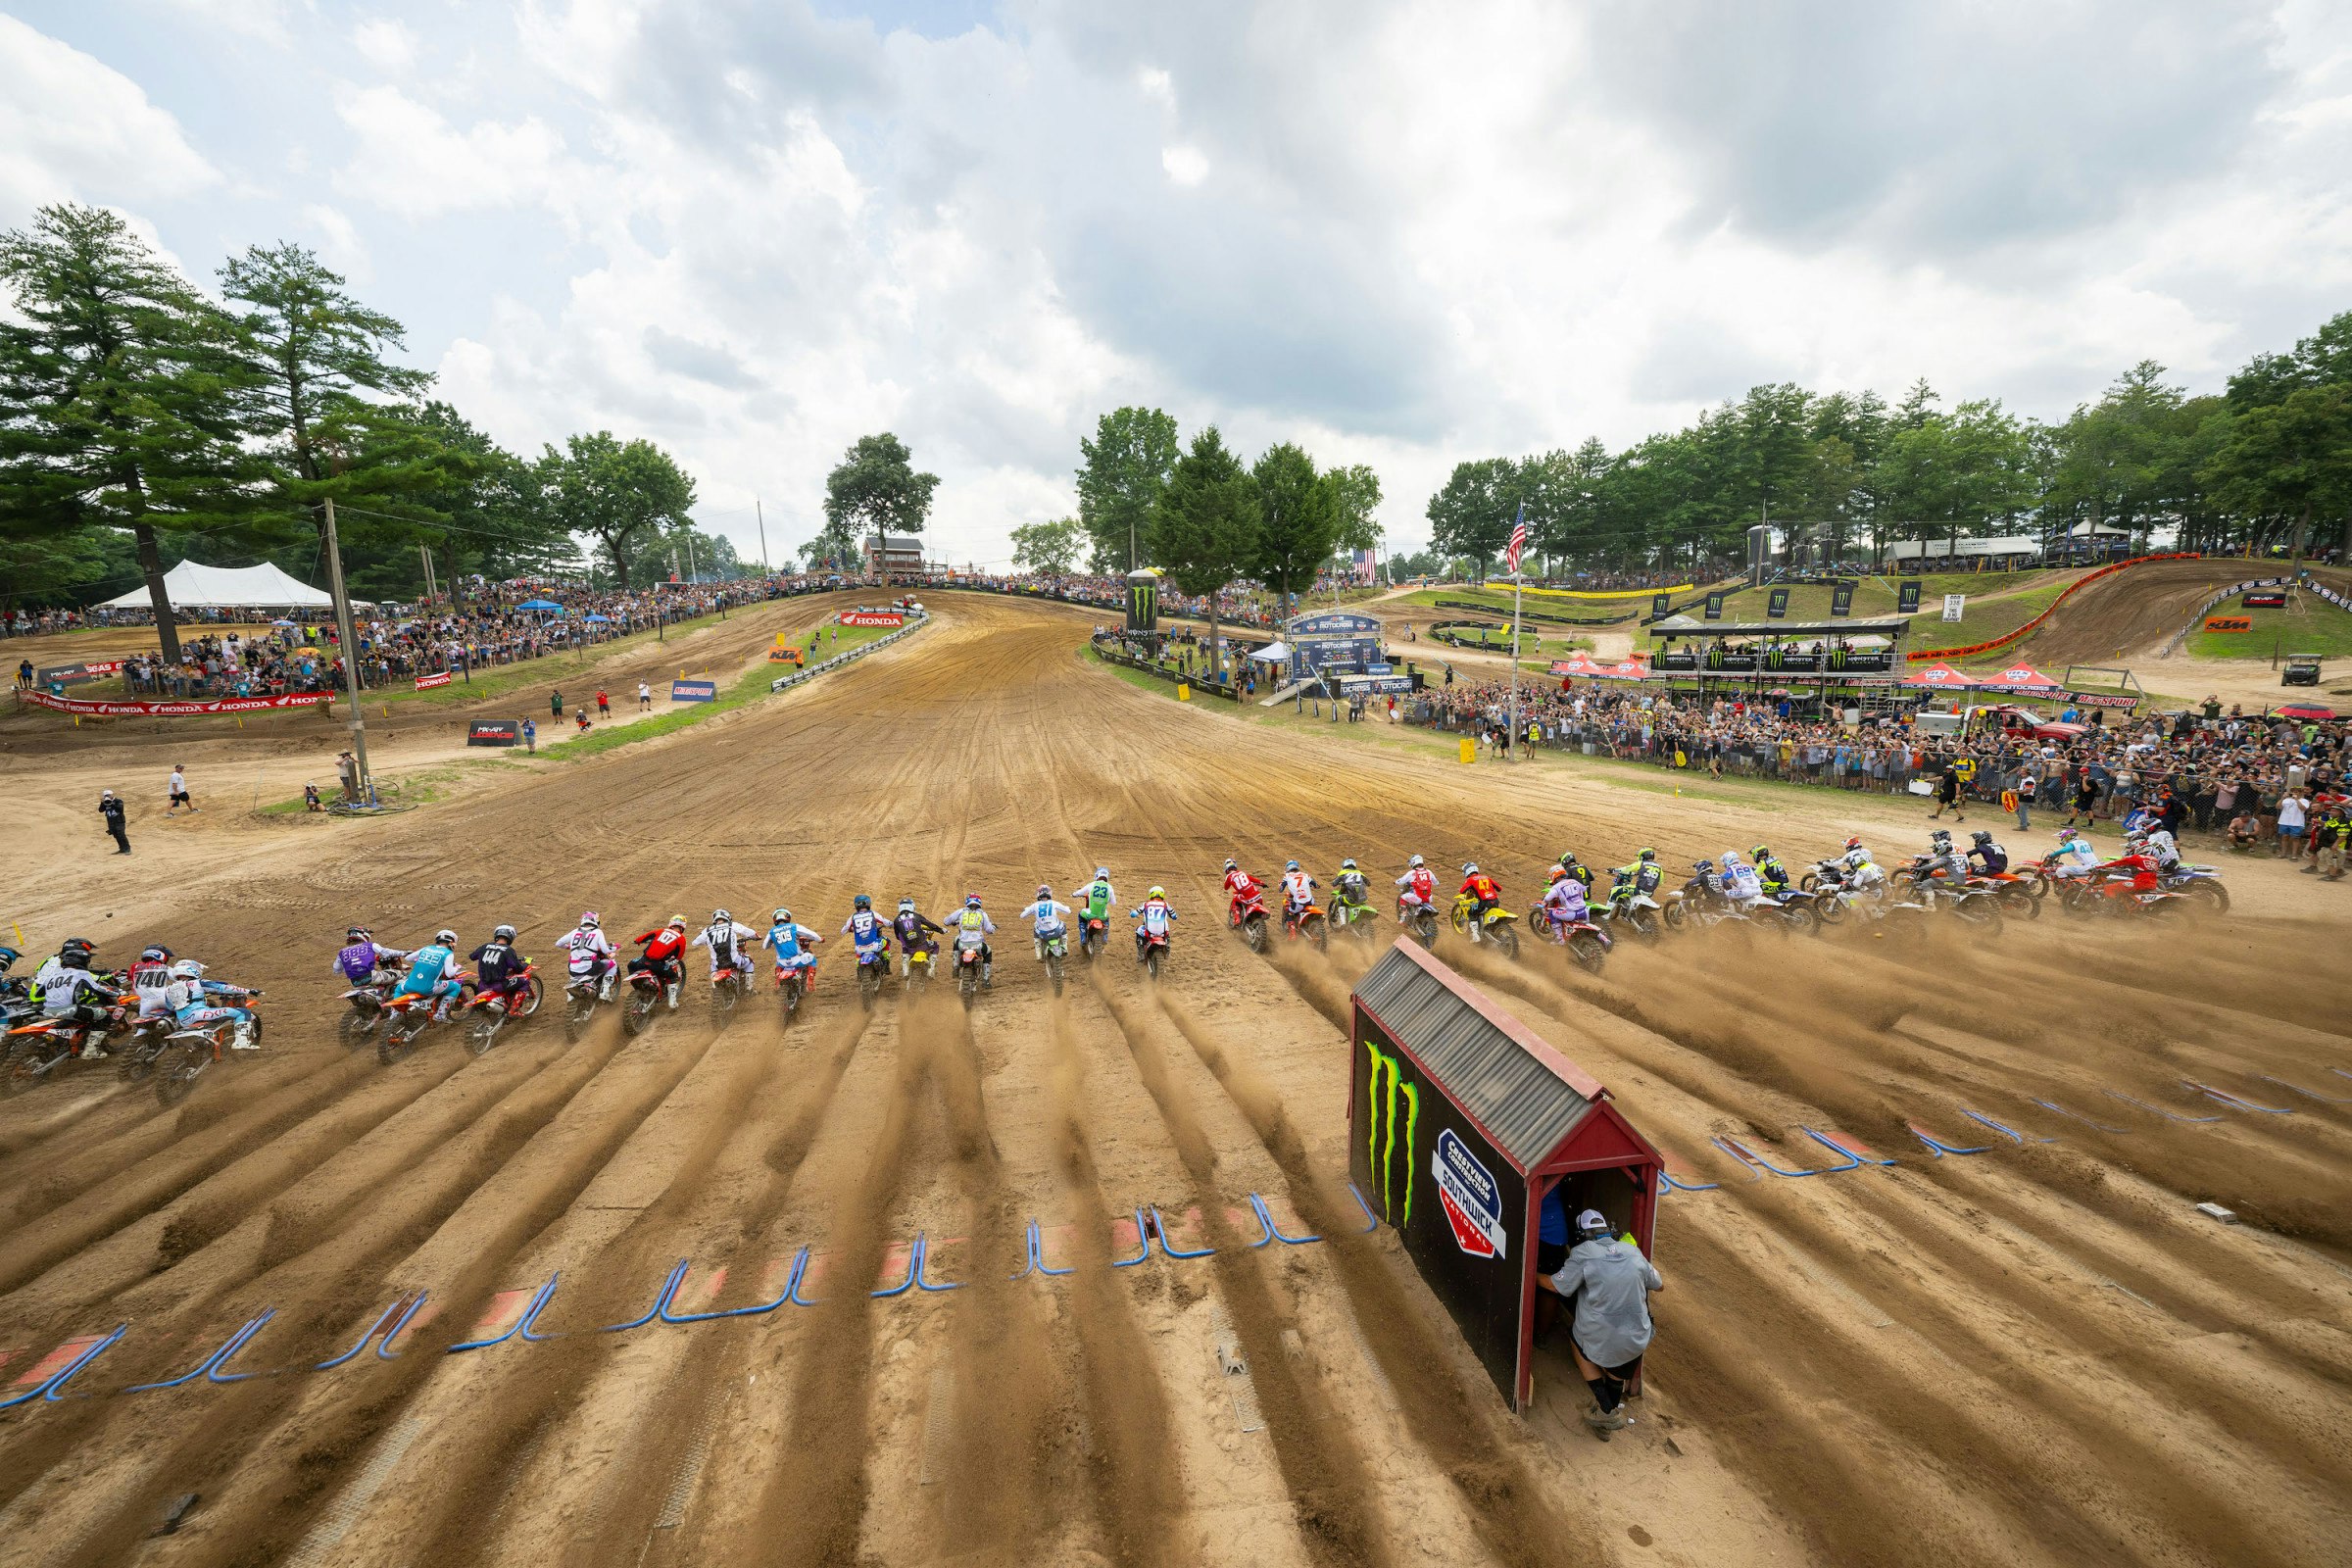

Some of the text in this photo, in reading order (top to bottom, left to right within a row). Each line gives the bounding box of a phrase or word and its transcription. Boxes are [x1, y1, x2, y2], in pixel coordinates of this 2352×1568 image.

[2206, 619, 2250, 630] KTM
[416, 676, 451, 688] HONDA
[70, 704, 96, 712] HONDA
[161, 706, 204, 714] HONDA
[221, 701, 271, 710] HONDA
[1345, 873, 1361, 883] 21
[1577, 867, 1586, 879] 9
[1642, 864, 1659, 879] 36
[1736, 866, 1752, 877] 69
[1234, 873, 1250, 890] 18
[1294, 876, 1303, 888] 7
[1478, 879, 1490, 890] 47
[1093, 885, 1107, 899] 23
[1038, 903, 1053, 918] 81
[1147, 906, 1164, 919] 87
[855, 917, 873, 934] 93
[961, 911, 983, 926] 387
[657, 932, 677, 946] 107
[710, 927, 730, 946] 787
[775, 929, 793, 945] 309
[481, 951, 502, 965] 444
[46, 974, 74, 991] 604
[223, 984, 247, 993] FXR
[203, 1007, 227, 1019] FXR
[1447, 1140, 1492, 1192] CRESTVIEW
[1447, 1151, 1491, 1201] CONSTRUCTION
[1443, 1169, 1493, 1238] SOUTHWICK
[1444, 1195, 1488, 1249] NATIONAL
